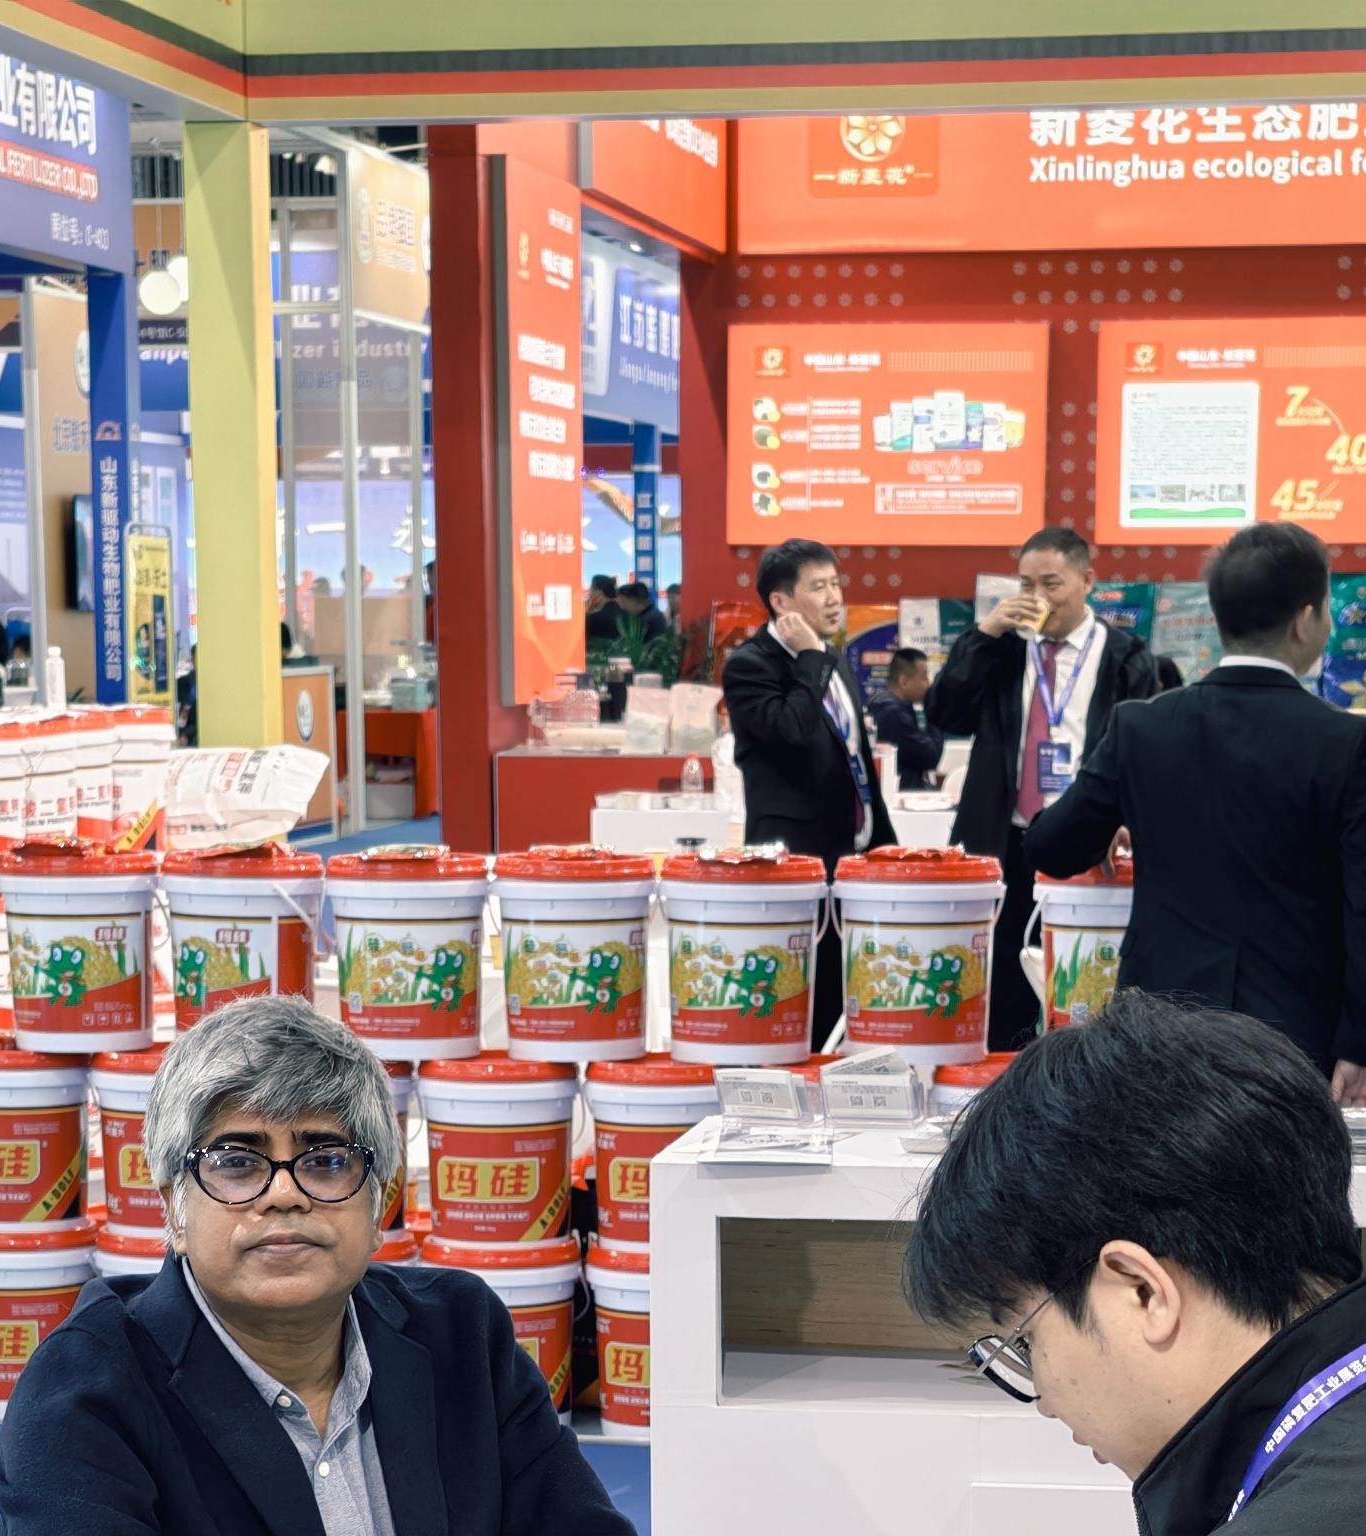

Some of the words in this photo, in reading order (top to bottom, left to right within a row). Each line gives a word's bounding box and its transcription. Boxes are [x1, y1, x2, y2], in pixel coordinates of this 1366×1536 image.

[1029, 154, 1185, 187] Xinlinghua
[1193, 149, 1342, 184] ecological
[1285, 386, 1310, 418] 7
[1270, 480, 1319, 511] 45
[445, 1162, 533, 1198] 玛硅
